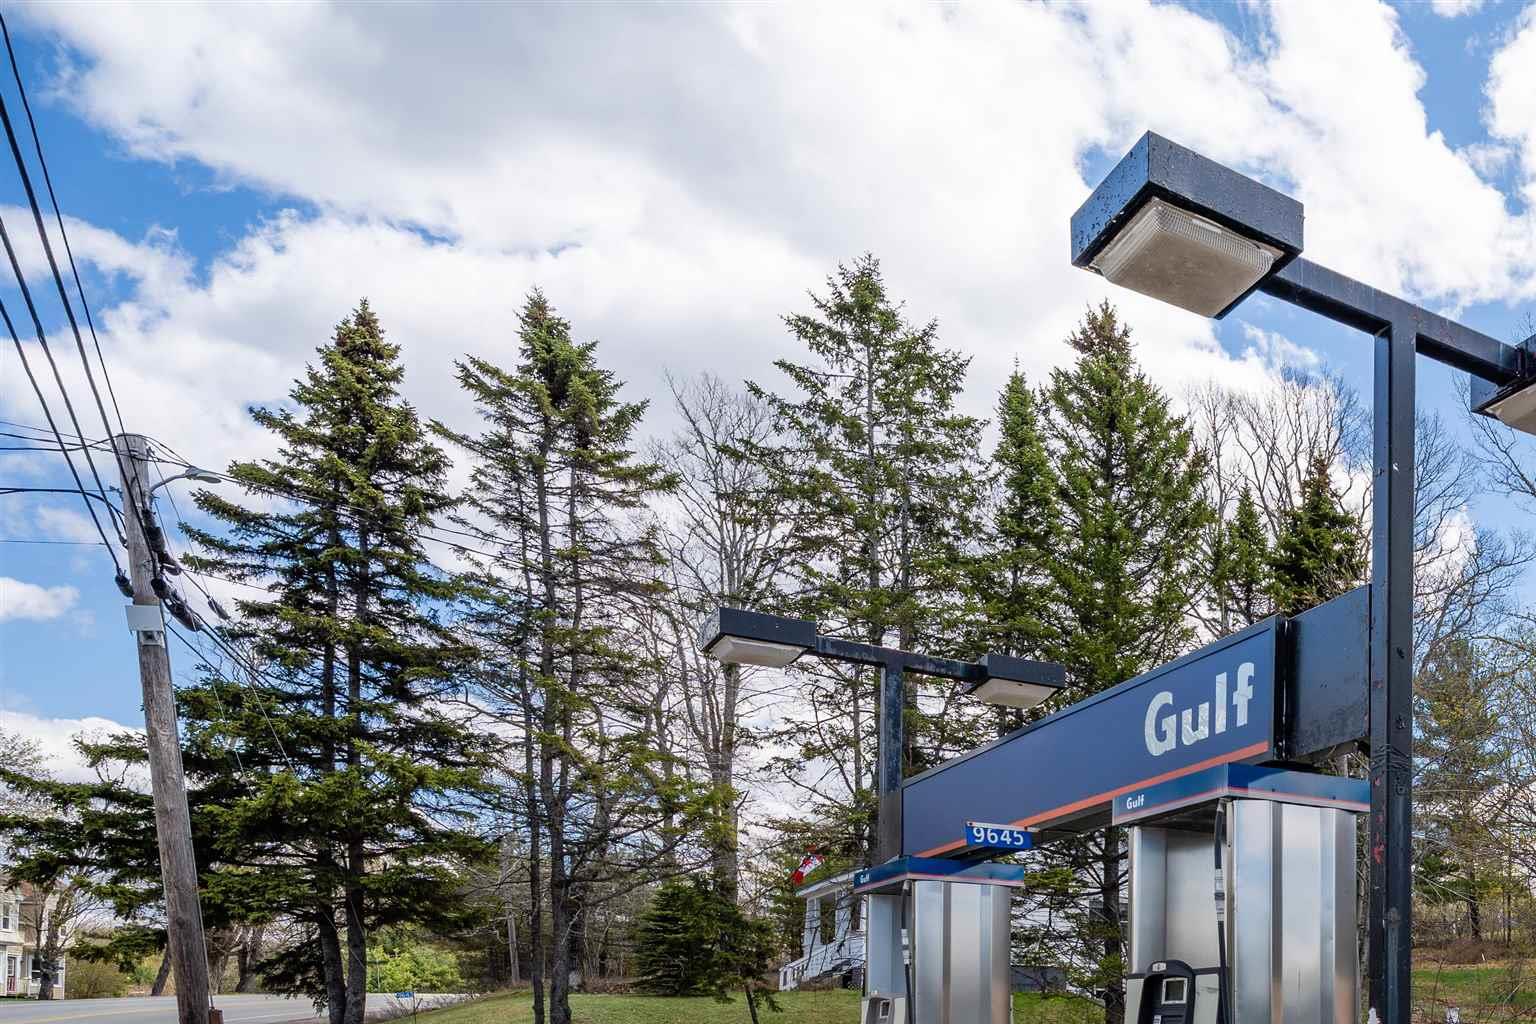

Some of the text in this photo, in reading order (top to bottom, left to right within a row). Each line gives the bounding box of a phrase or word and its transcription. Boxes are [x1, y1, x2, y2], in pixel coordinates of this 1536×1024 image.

[1144, 662, 1255, 757] Gulf
[1126, 794, 1145, 809] Gulf
[972, 827, 1024, 846] 9645
